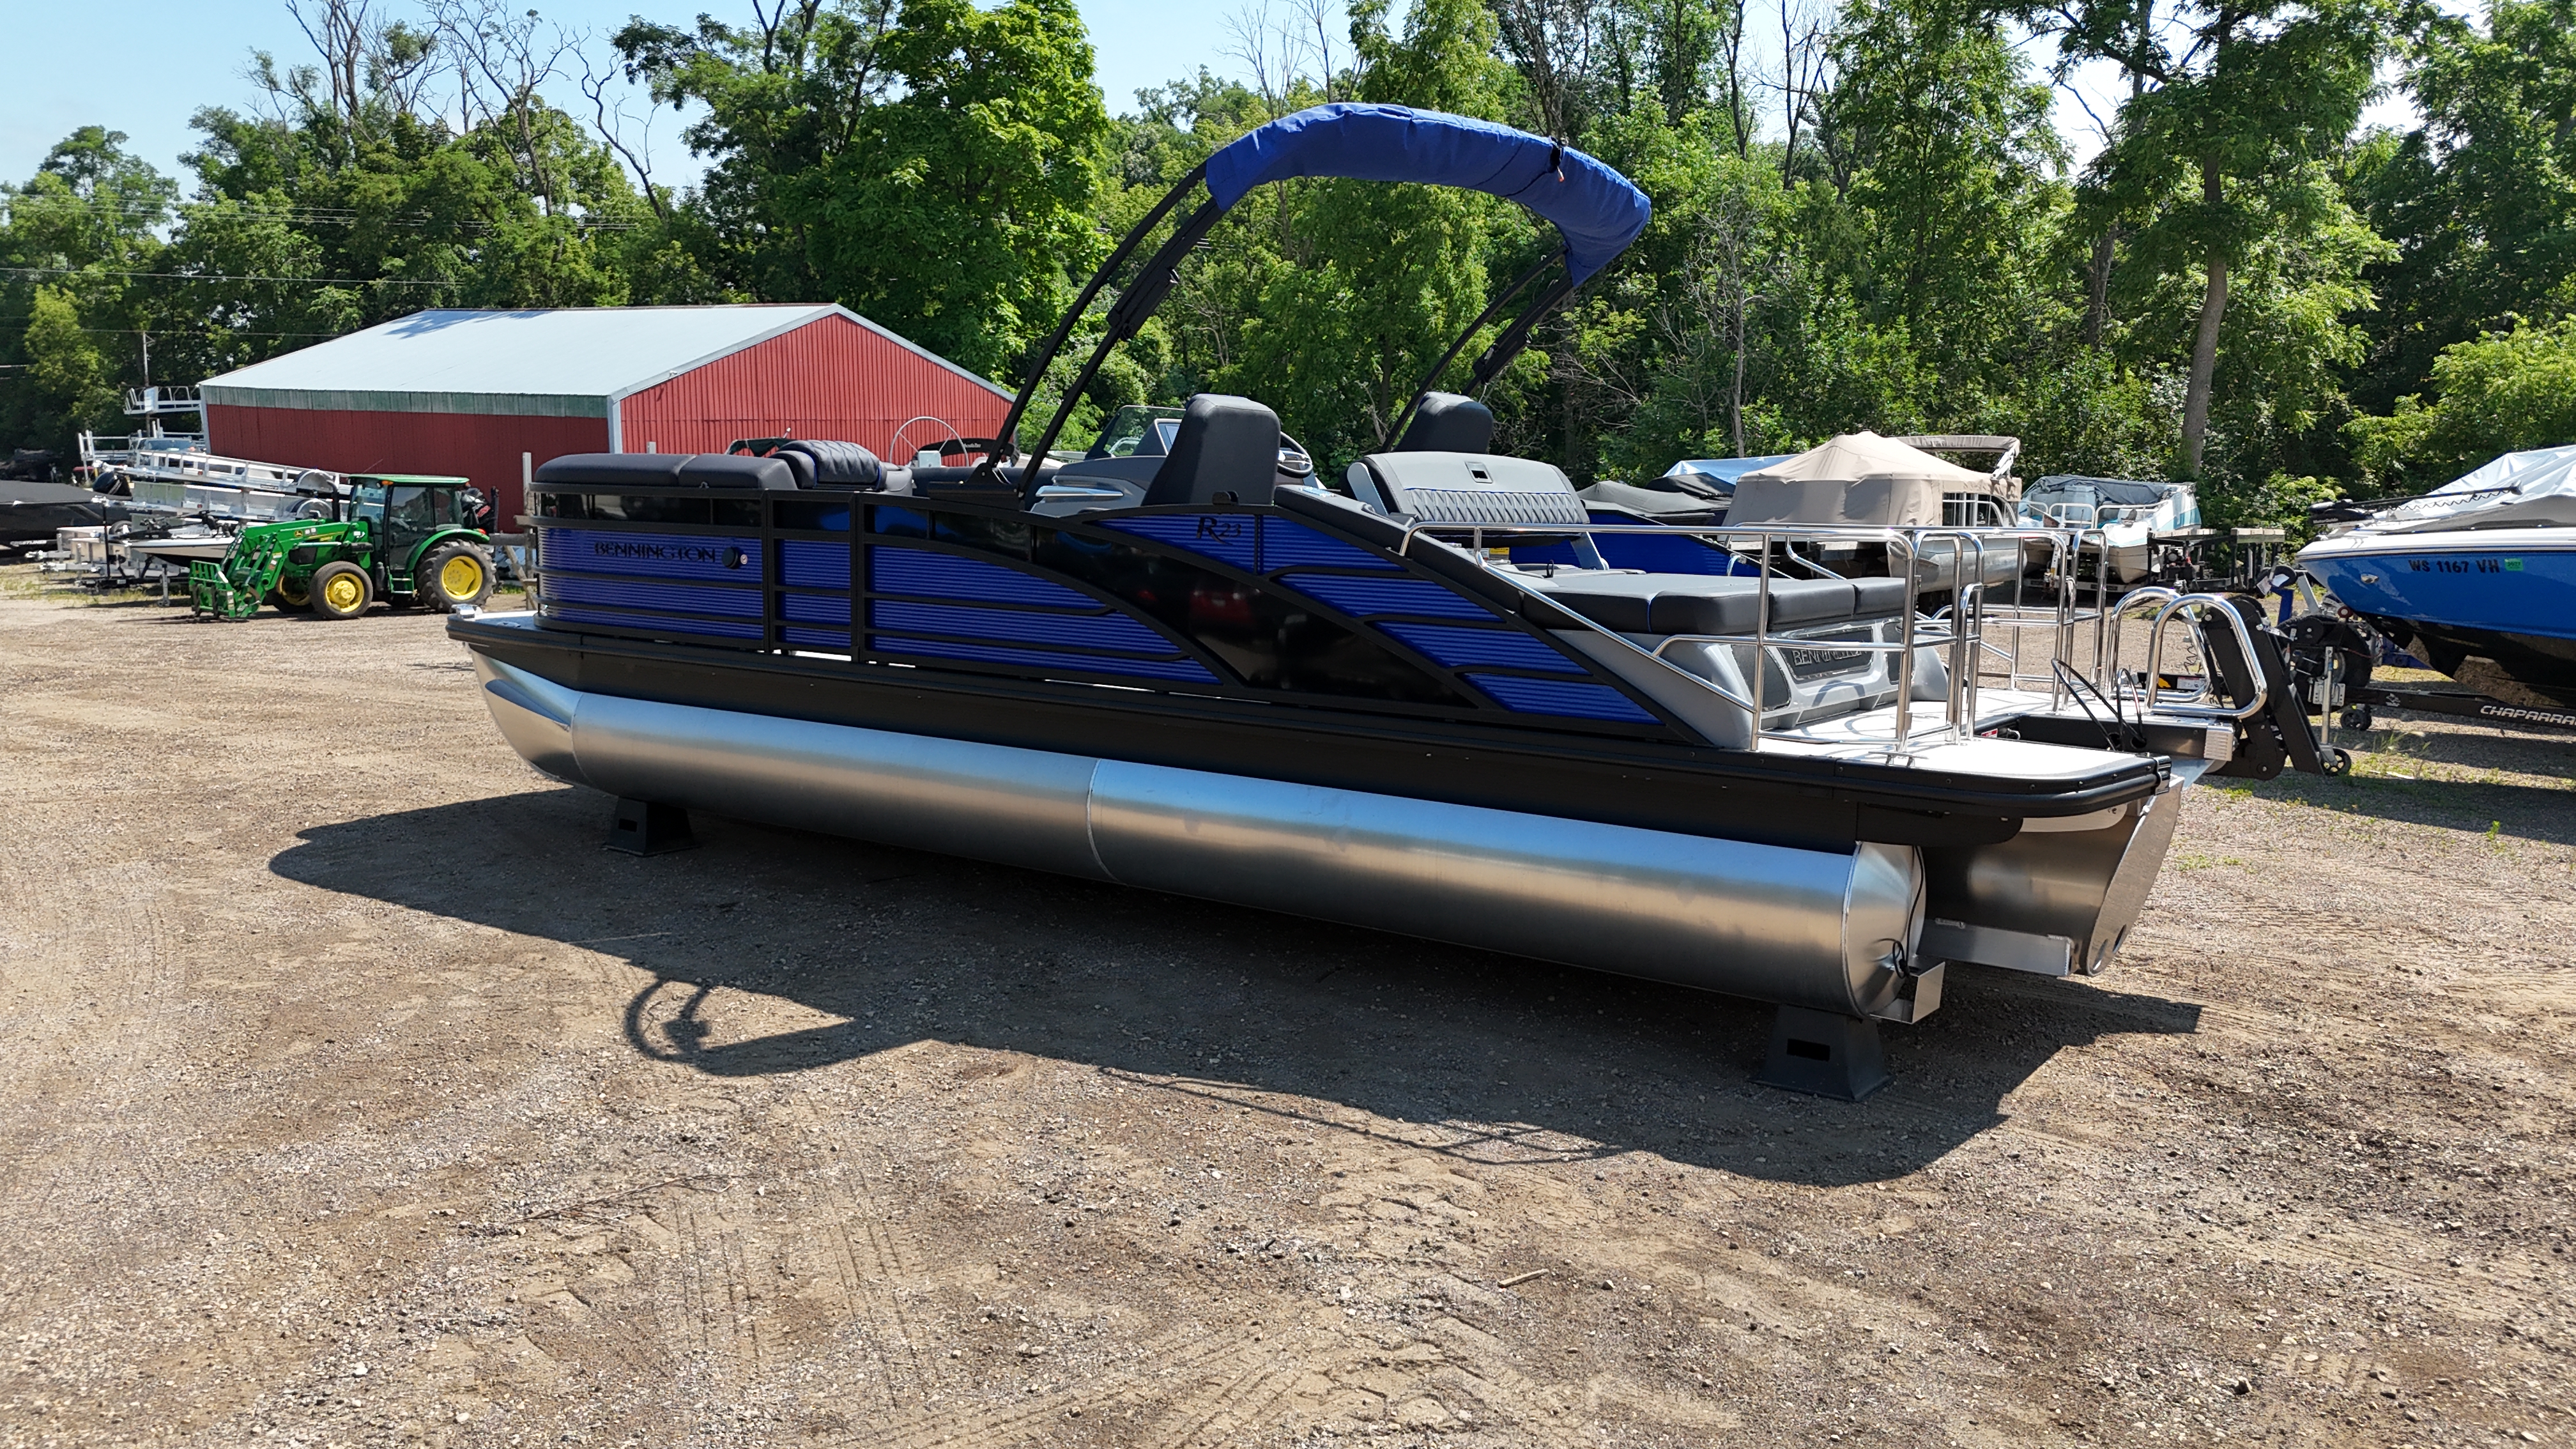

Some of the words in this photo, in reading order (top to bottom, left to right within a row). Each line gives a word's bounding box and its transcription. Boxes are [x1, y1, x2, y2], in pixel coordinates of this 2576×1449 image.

[594, 542, 716, 563] BENNINGTON
[2408, 559, 2430, 572] WS
[2436, 560, 2469, 573] 1167
[2476, 558, 2500, 573] VH
[2480, 705, 2576, 726] CHAPARRA
